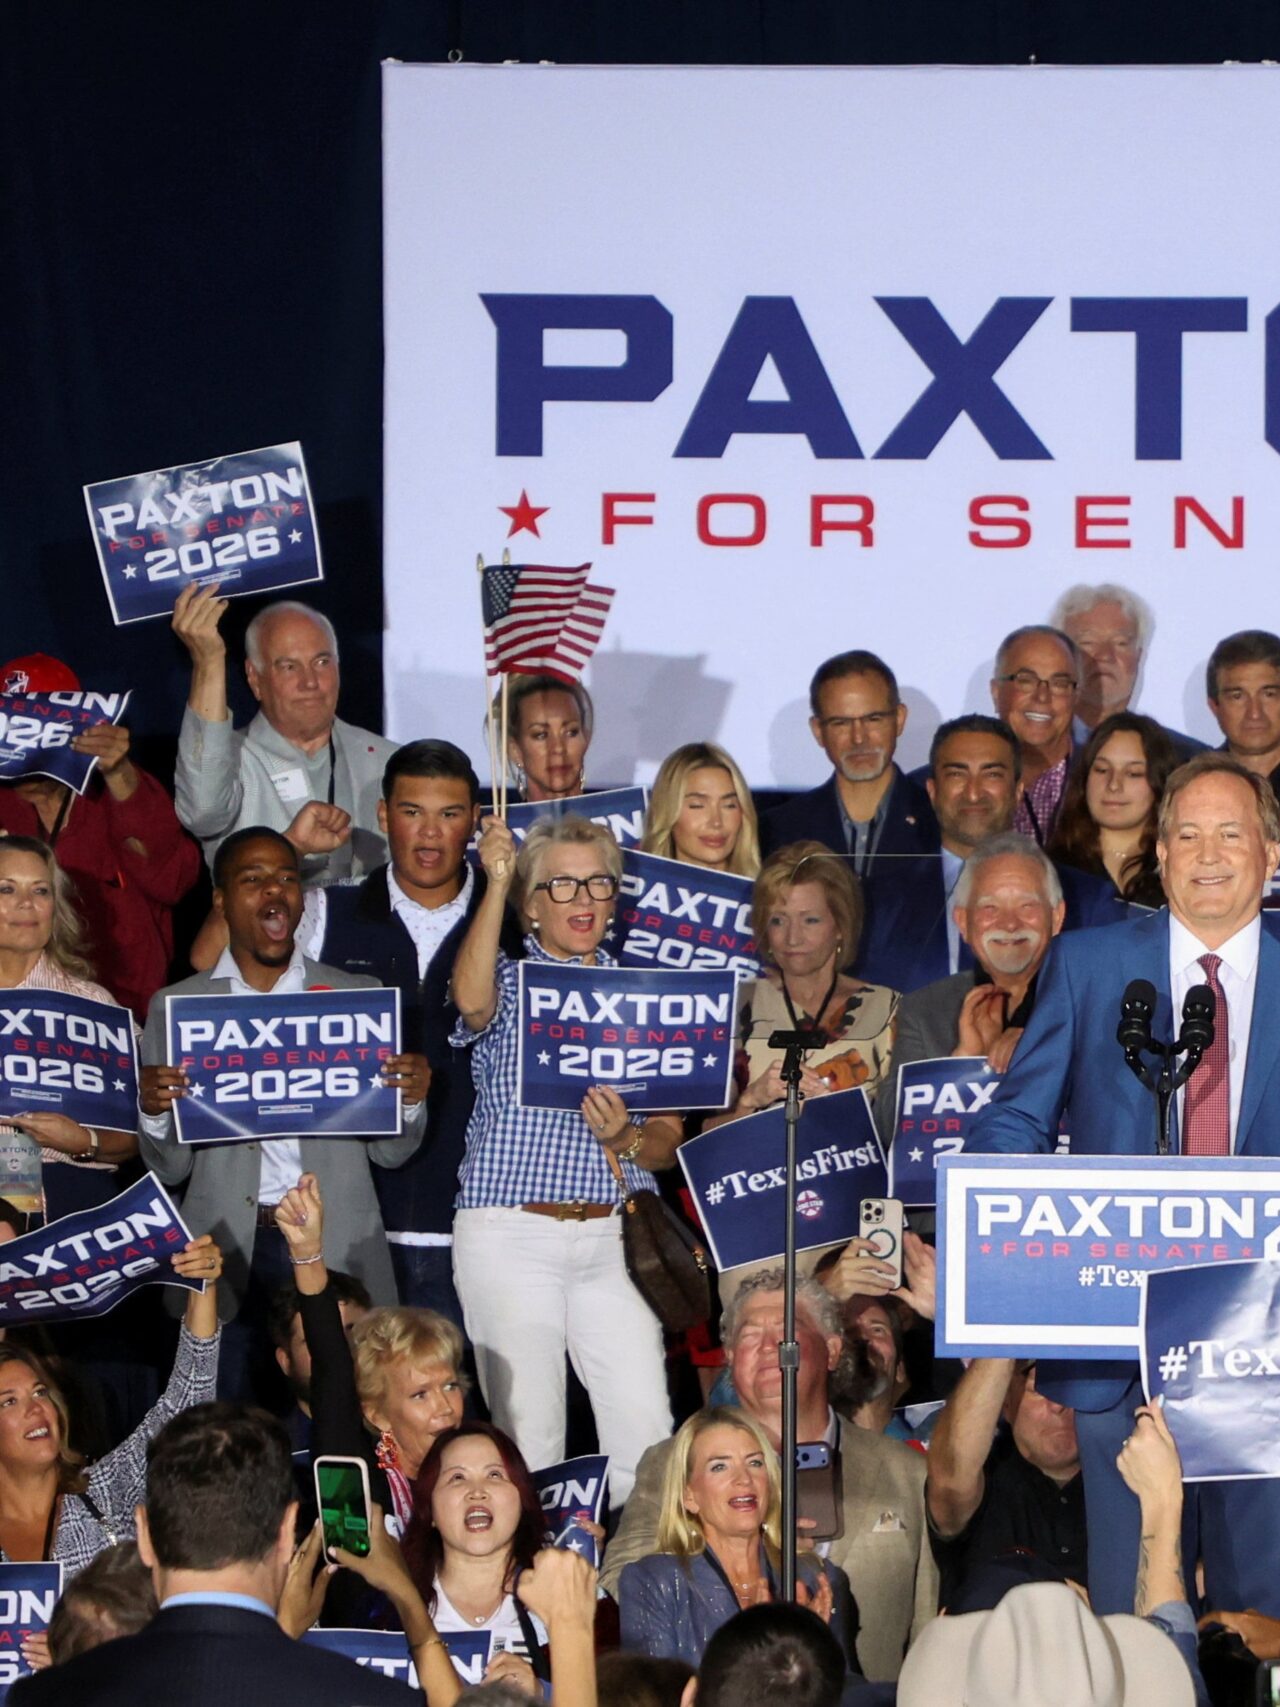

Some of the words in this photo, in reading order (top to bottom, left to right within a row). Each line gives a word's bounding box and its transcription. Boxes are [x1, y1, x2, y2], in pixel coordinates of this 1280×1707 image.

[98, 467, 301, 537] PAXTON
[602, 493, 874, 547] FOR
[108, 531, 169, 553] FOR
[185, 502, 305, 538] SENATE
[144, 526, 281, 582] 2026
[619, 873, 755, 936] PAXTO
[623, 909, 662, 929] OR
[677, 924, 758, 953] SENA
[528, 987, 730, 1025] PAXTON
[0, 1008, 130, 1054] XTON
[178, 1012, 392, 1052] PAXTON
[529, 1022, 585, 1040] FOR
[603, 1027, 726, 1044] SENATE
[13, 1038, 130, 1069] SENATE
[181, 1054, 244, 1070] FOR
[263, 1047, 392, 1065] SENATE
[559, 1044, 695, 1080] 2026
[0, 1054, 105, 1094] 026
[215, 1066, 360, 1104] 2026
[903, 1082, 1000, 1116] PAX
[902, 1118, 961, 1133] FOR
[974, 1194, 1254, 1239] PAXTON
[0, 1197, 172, 1283] AXTON
[1003, 1242, 1070, 1258] FOR
[1089, 1243, 1230, 1259] SENATE
